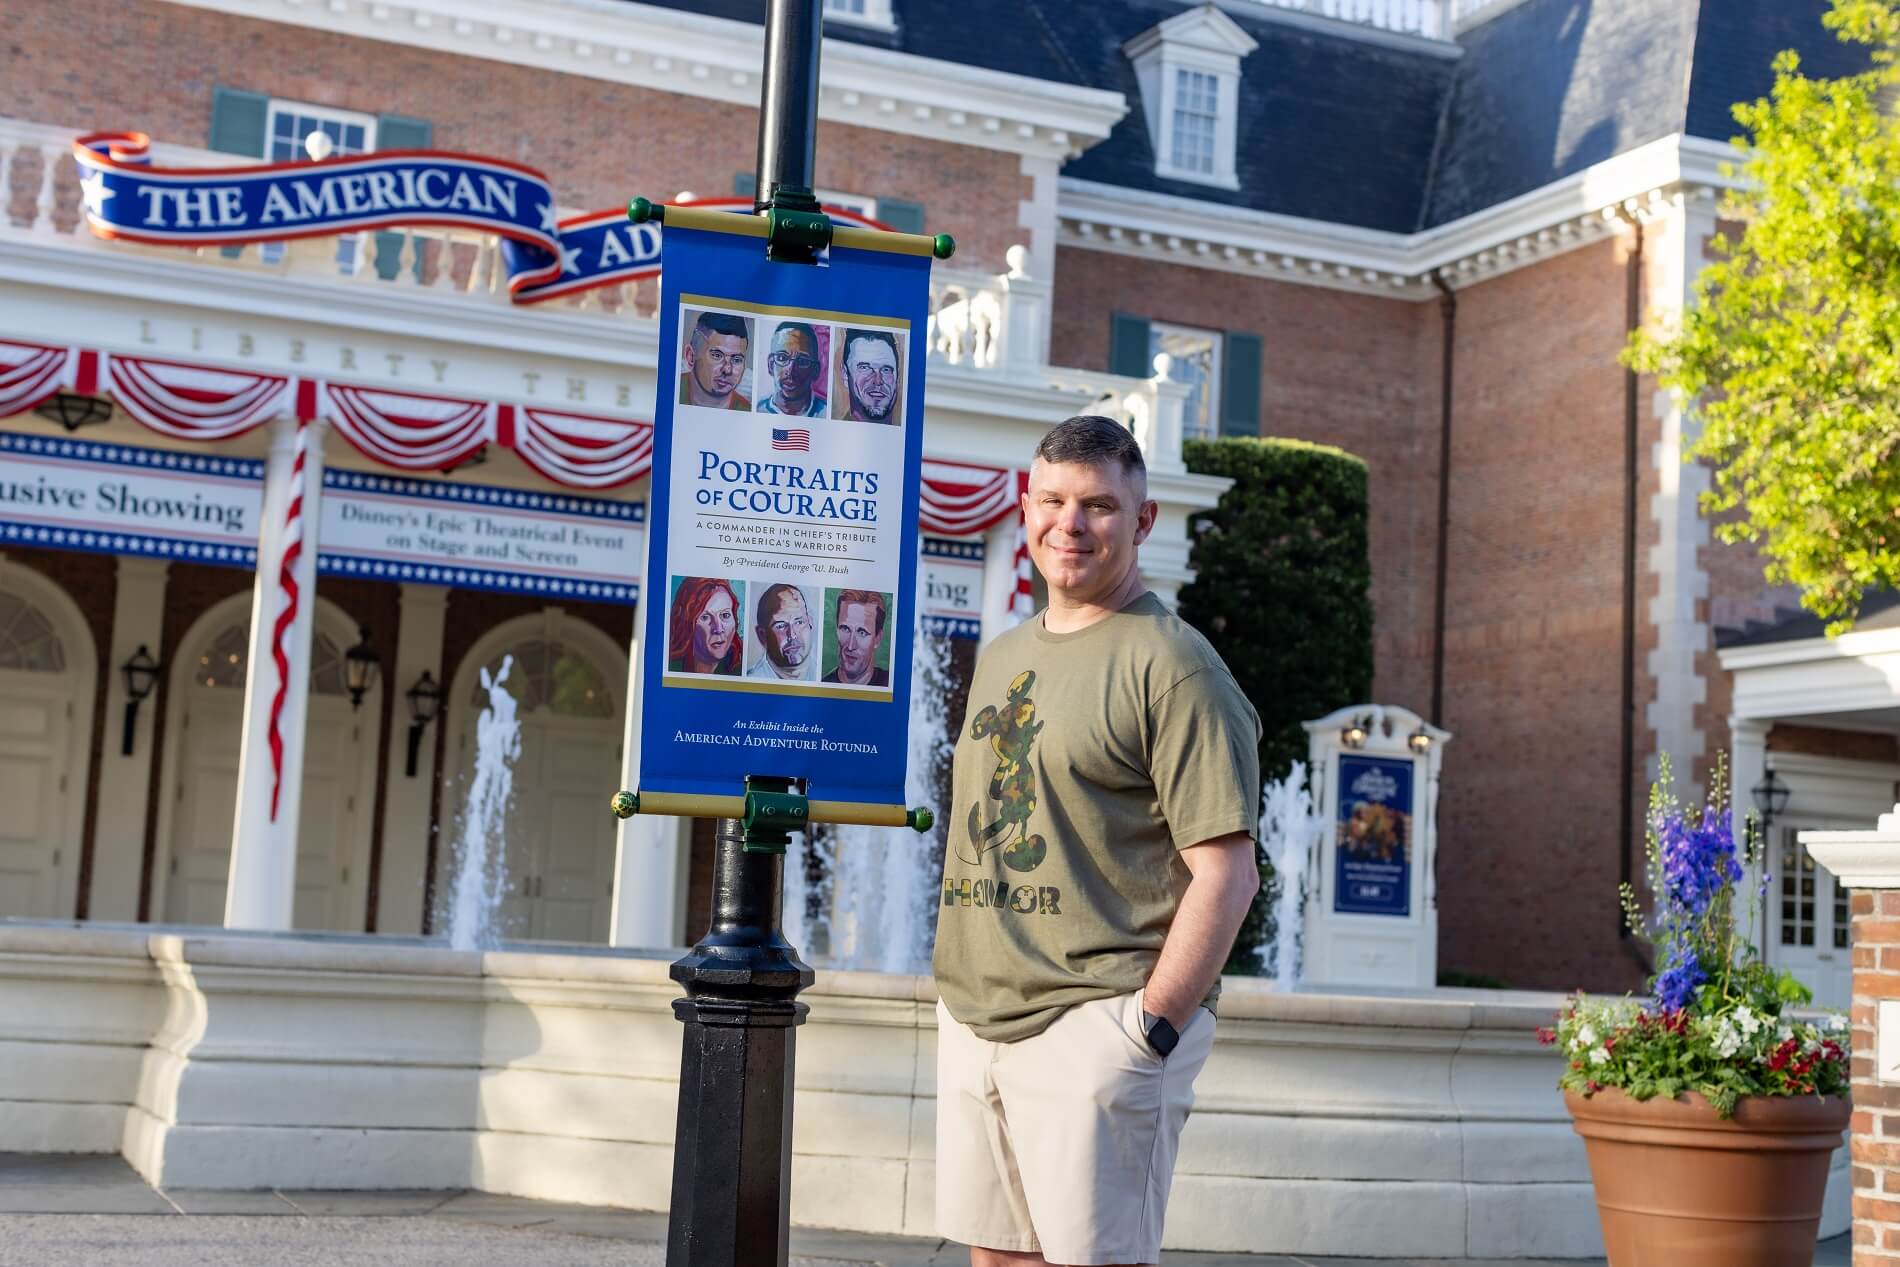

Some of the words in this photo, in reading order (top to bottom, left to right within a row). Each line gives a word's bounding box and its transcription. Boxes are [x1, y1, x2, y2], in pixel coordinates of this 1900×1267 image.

[137, 185, 248, 227] THE
[260, 169, 518, 223] AMERICAN
[139, 320, 449, 381] LIBERTY
[522, 372, 630, 406] THE
[697, 451, 879, 495] PORTRAITS
[96, 482, 245, 532] Showing
[696, 489, 724, 506] OF
[728, 488, 877, 522] COURAGE
[341, 502, 419, 530] Disney's
[426, 512, 465, 534] Epic
[472, 517, 567, 544] Theatrical
[572, 527, 624, 550] Event
[696, 521, 703, 529] A
[706, 522, 775, 535] COMMANDER
[779, 528, 790, 536] IN
[793, 529, 833, 540] CHIEF'S
[836, 533, 877, 544] TRIBUTE
[386, 534, 411, 548] on
[418, 533, 468, 556] Stage
[473, 542, 509, 558] and
[515, 544, 578, 565] Screen
[718, 534, 732, 543] TO
[735, 536, 790, 548] AMERICA'S
[794, 541, 848, 553] WARRIORS
[722, 556, 735, 568] By
[736, 557, 780, 570] President
[781, 561, 810, 574] George
[811, 563, 826, 573] W.
[828, 566, 849, 575] Bush
[926, 573, 968, 608] ing
[674, 730, 740, 745] AMERICAN
[743, 735, 818, 750] ADVENTURE
[821, 739, 878, 754] ROTUNDA
[733, 720, 747, 729] An
[749, 720, 780, 732] Exhibit
[782, 722, 808, 733] Inside
[810, 724, 824, 734] the
